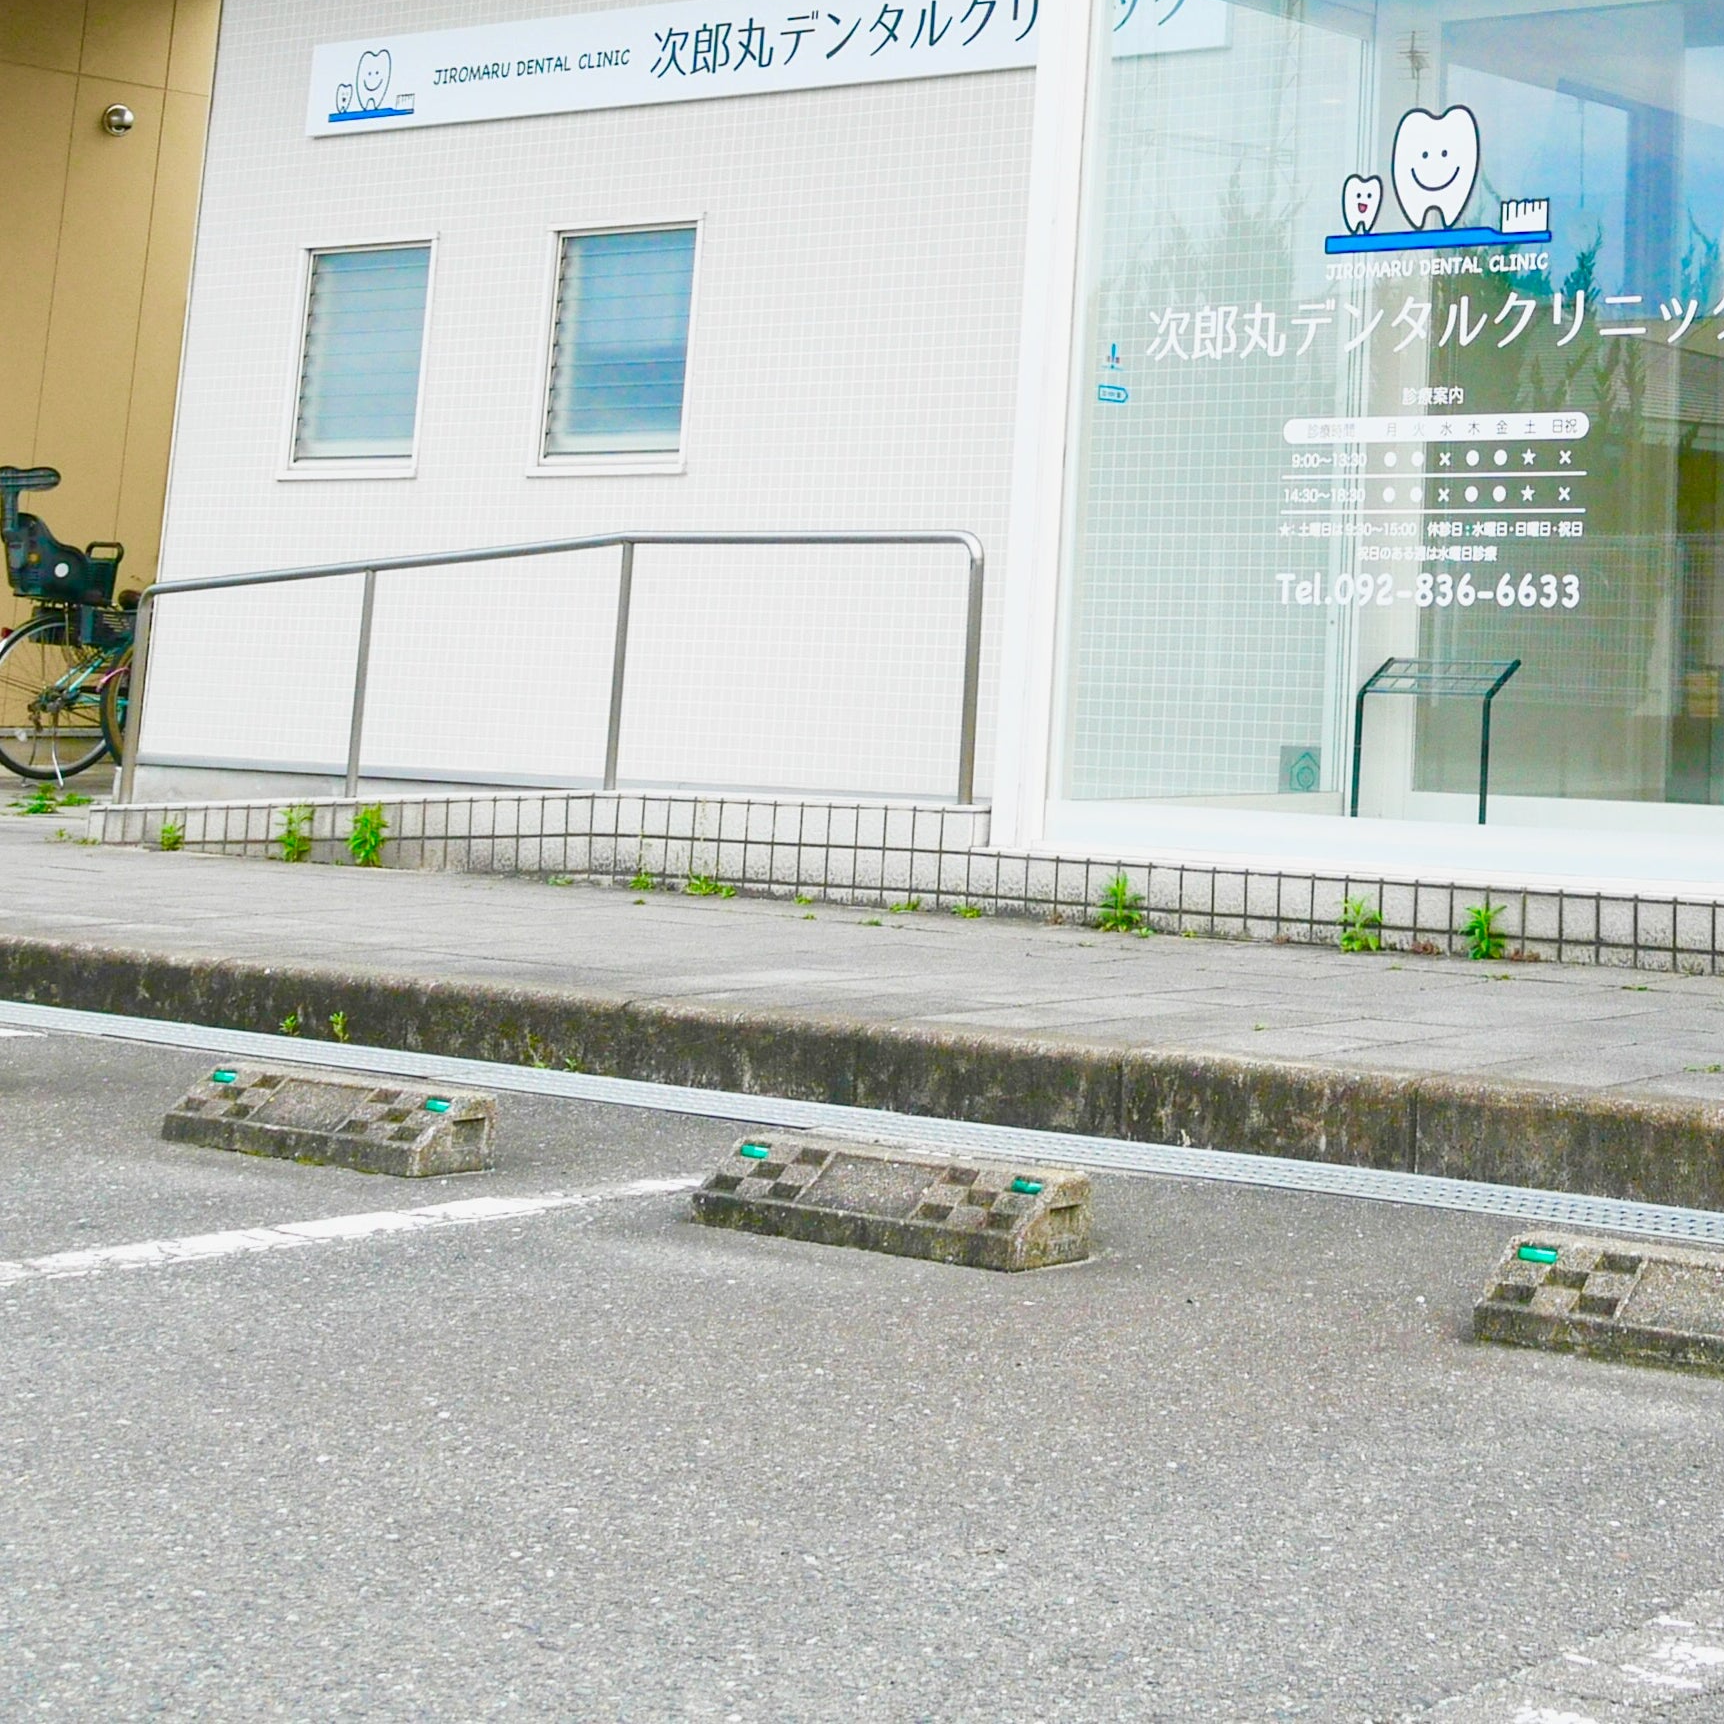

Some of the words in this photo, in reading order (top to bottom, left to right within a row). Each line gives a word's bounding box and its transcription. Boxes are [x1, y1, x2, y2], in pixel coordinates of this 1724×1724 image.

[432, 62, 511, 86] JIROMARU
[516, 55, 572, 77] DENTAL
[578, 48, 631, 69] CLINIC
[1326, 259, 1414, 278] JIROMARU
[1419, 255, 1483, 276] DENTAL
[1489, 252, 1549, 272] CLINIC
[1401, 386, 1464, 406] 診療案内
[1386, 422, 1398, 437] 月
[1440, 420, 1453, 436] 水
[1467, 420, 1481, 435] 木
[1495, 419, 1509, 435] 金
[1523, 419, 1537, 434] 土
[1275, 572, 1581, 609] Tel.092-836-6633
